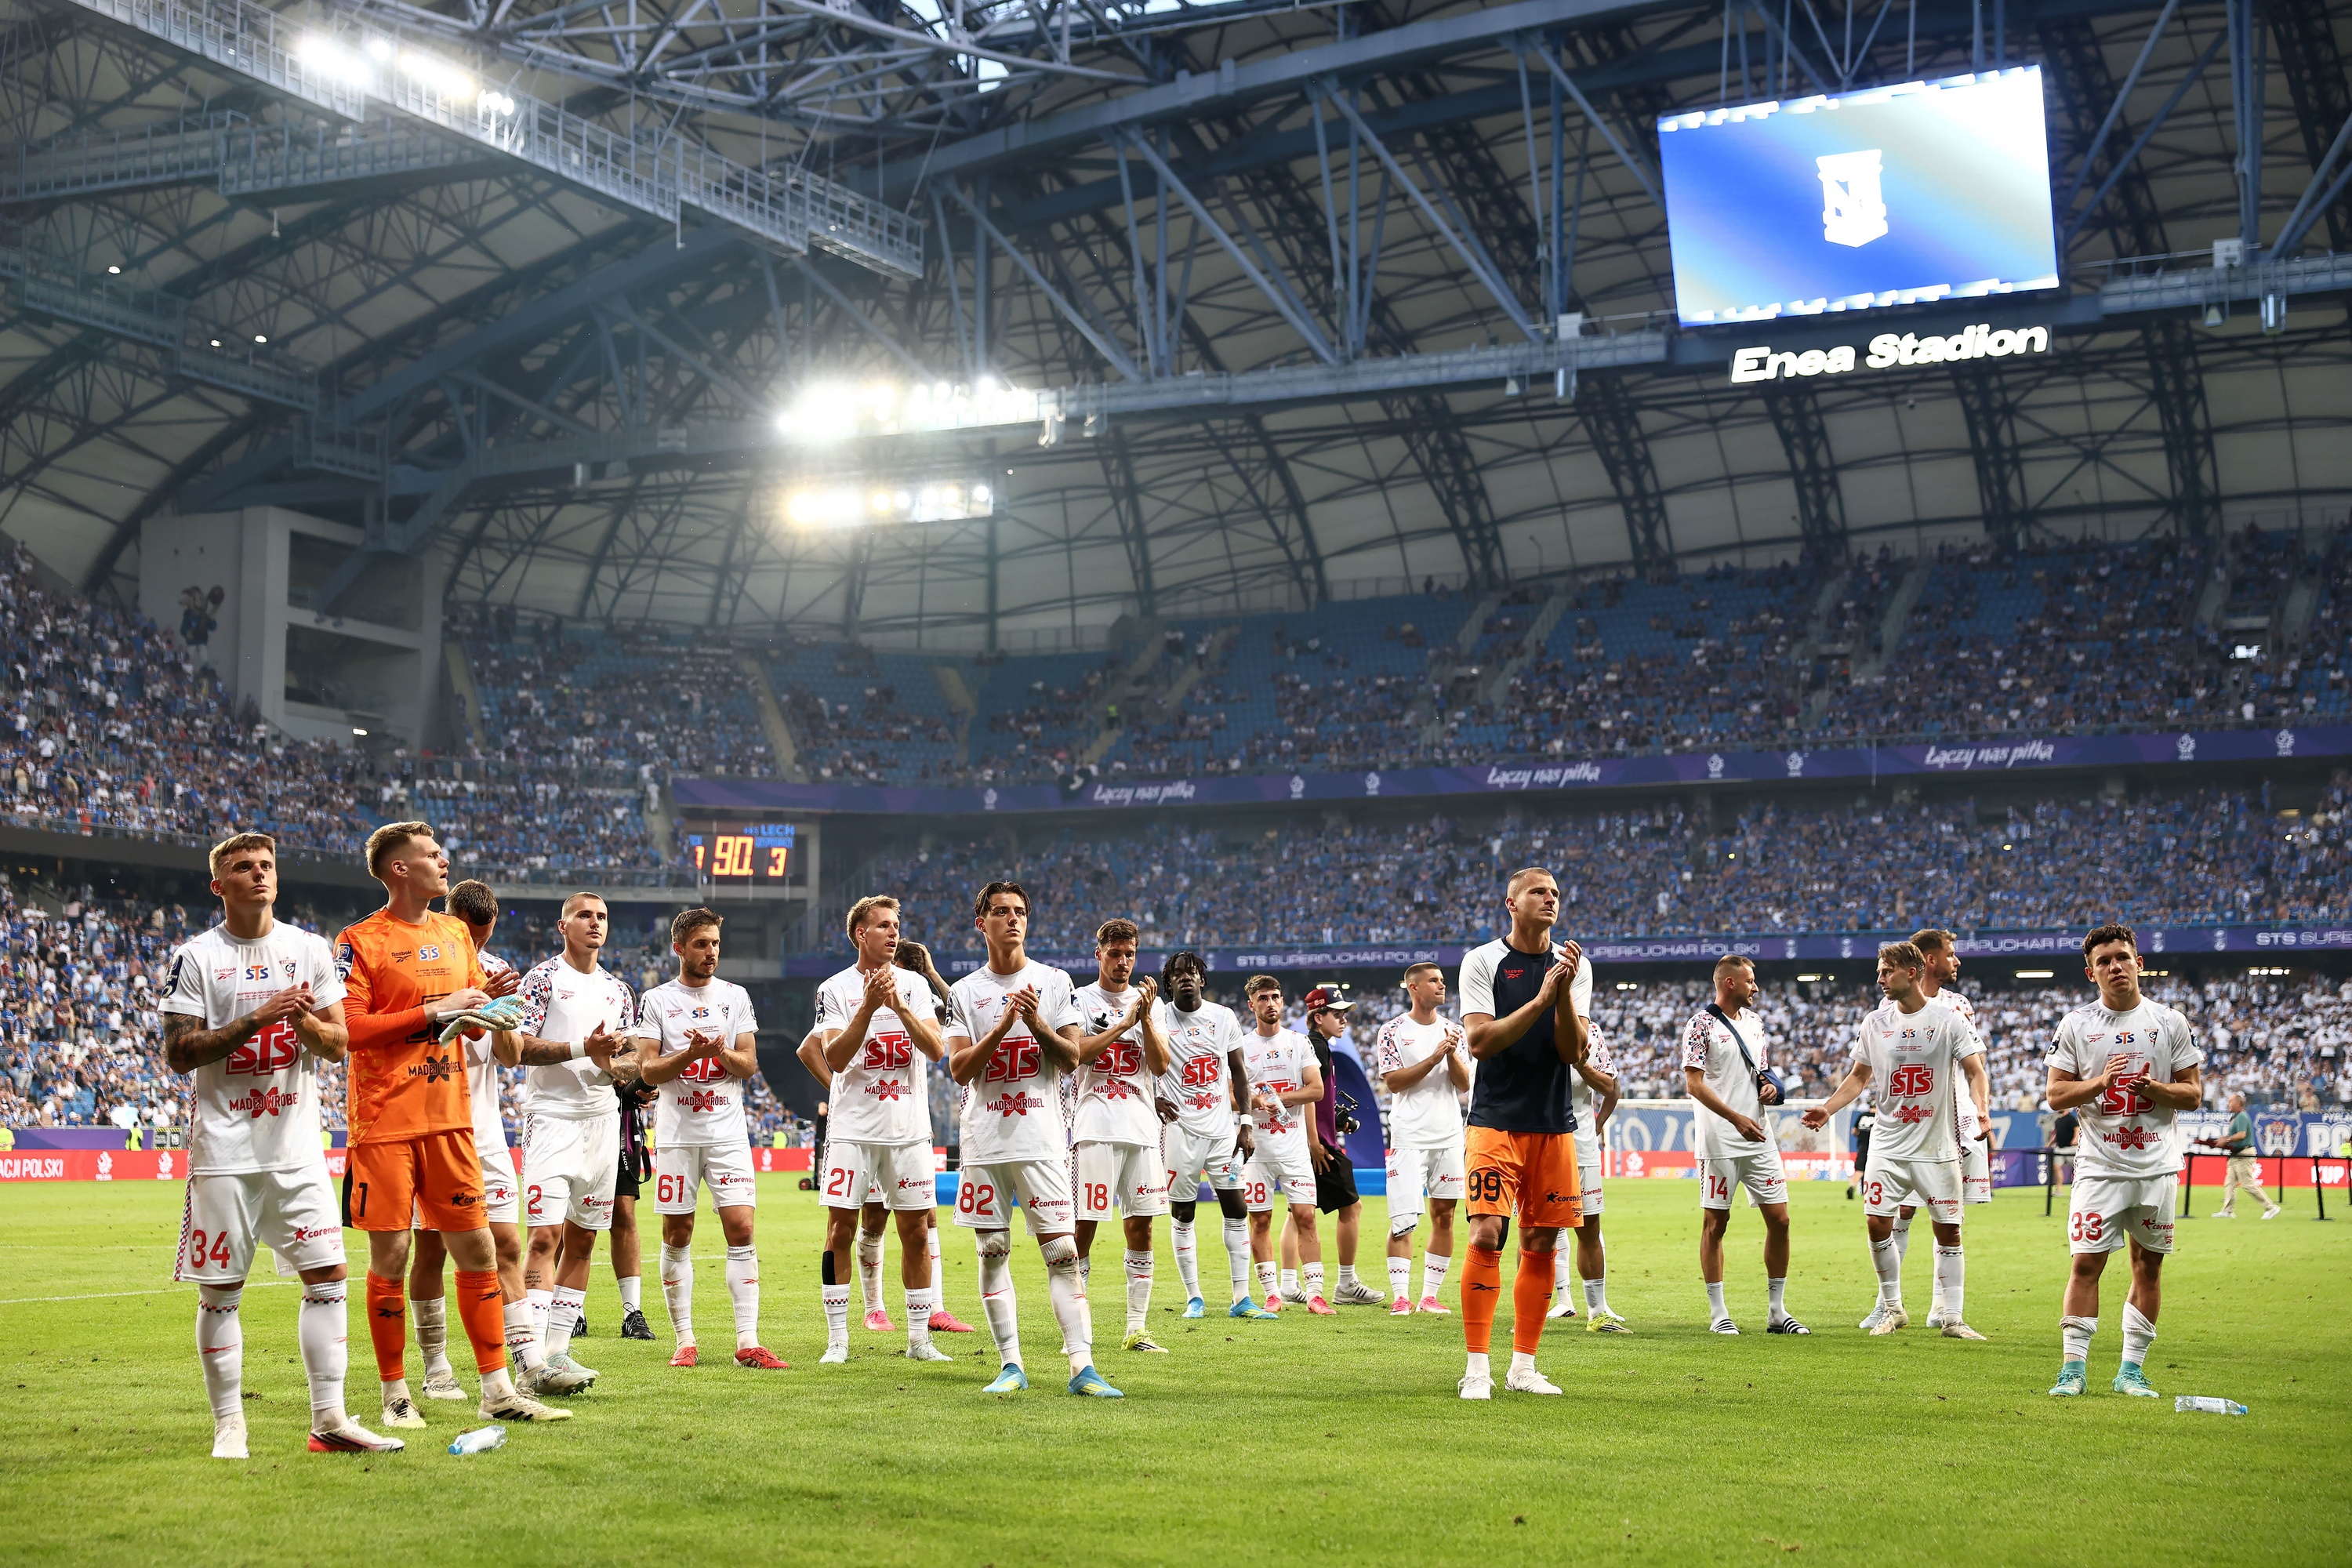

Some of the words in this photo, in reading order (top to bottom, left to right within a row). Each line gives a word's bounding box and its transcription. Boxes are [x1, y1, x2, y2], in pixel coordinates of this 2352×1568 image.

[1731, 346, 1856, 383] Enea
[1865, 323, 2049, 369] Stadion
[1976, 746, 2009, 764] nas
[768, 847, 787, 877] 3
[1701, 942, 1760, 955] POLSKI
[1955, 938, 2053, 953] ERPUCHAR
[2256, 932, 2296, 946] STS
[419, 945, 439, 960] STS
[1385, 950, 1439, 963] POLSKI
[245, 964, 269, 981] STS
[692, 1007, 709, 1018] STS
[1109, 1009, 1123, 1018] STS
[1187, 1028, 1200, 1036] STS
[1902, 1029, 1915, 1039] STS
[2115, 1032, 2134, 1044] STS
[864, 1030, 913, 1071] STS
[985, 1036, 1042, 1083] STS
[1092, 1040, 1142, 1077] STS
[1267, 1050, 1279, 1059] STS
[1181, 1053, 1220, 1087] STS
[864, 1086, 888, 1094] MADEJ
[1890, 1064, 1933, 1098] STS
[677, 1096, 702, 1106] MADEJ
[986, 1101, 1014, 1112] MADEJ
[2103, 1132, 2131, 1143] MADEJ
[22, 1158, 64, 1178] POLSKI
[657, 1174, 684, 1203] 61
[827, 1167, 855, 1198] 21
[1244, 1182, 1265, 1203] 28
[1469, 1171, 1501, 1202] 99
[1709, 1175, 1728, 1200] 14
[358, 1182, 368, 1217] 1
[528, 1185, 542, 1214] 2
[960, 1182, 994, 1215] 82
[1085, 1183, 1108, 1210] 18
[2071, 1212, 2103, 1241] 33
[191, 1229, 230, 1269] 34
